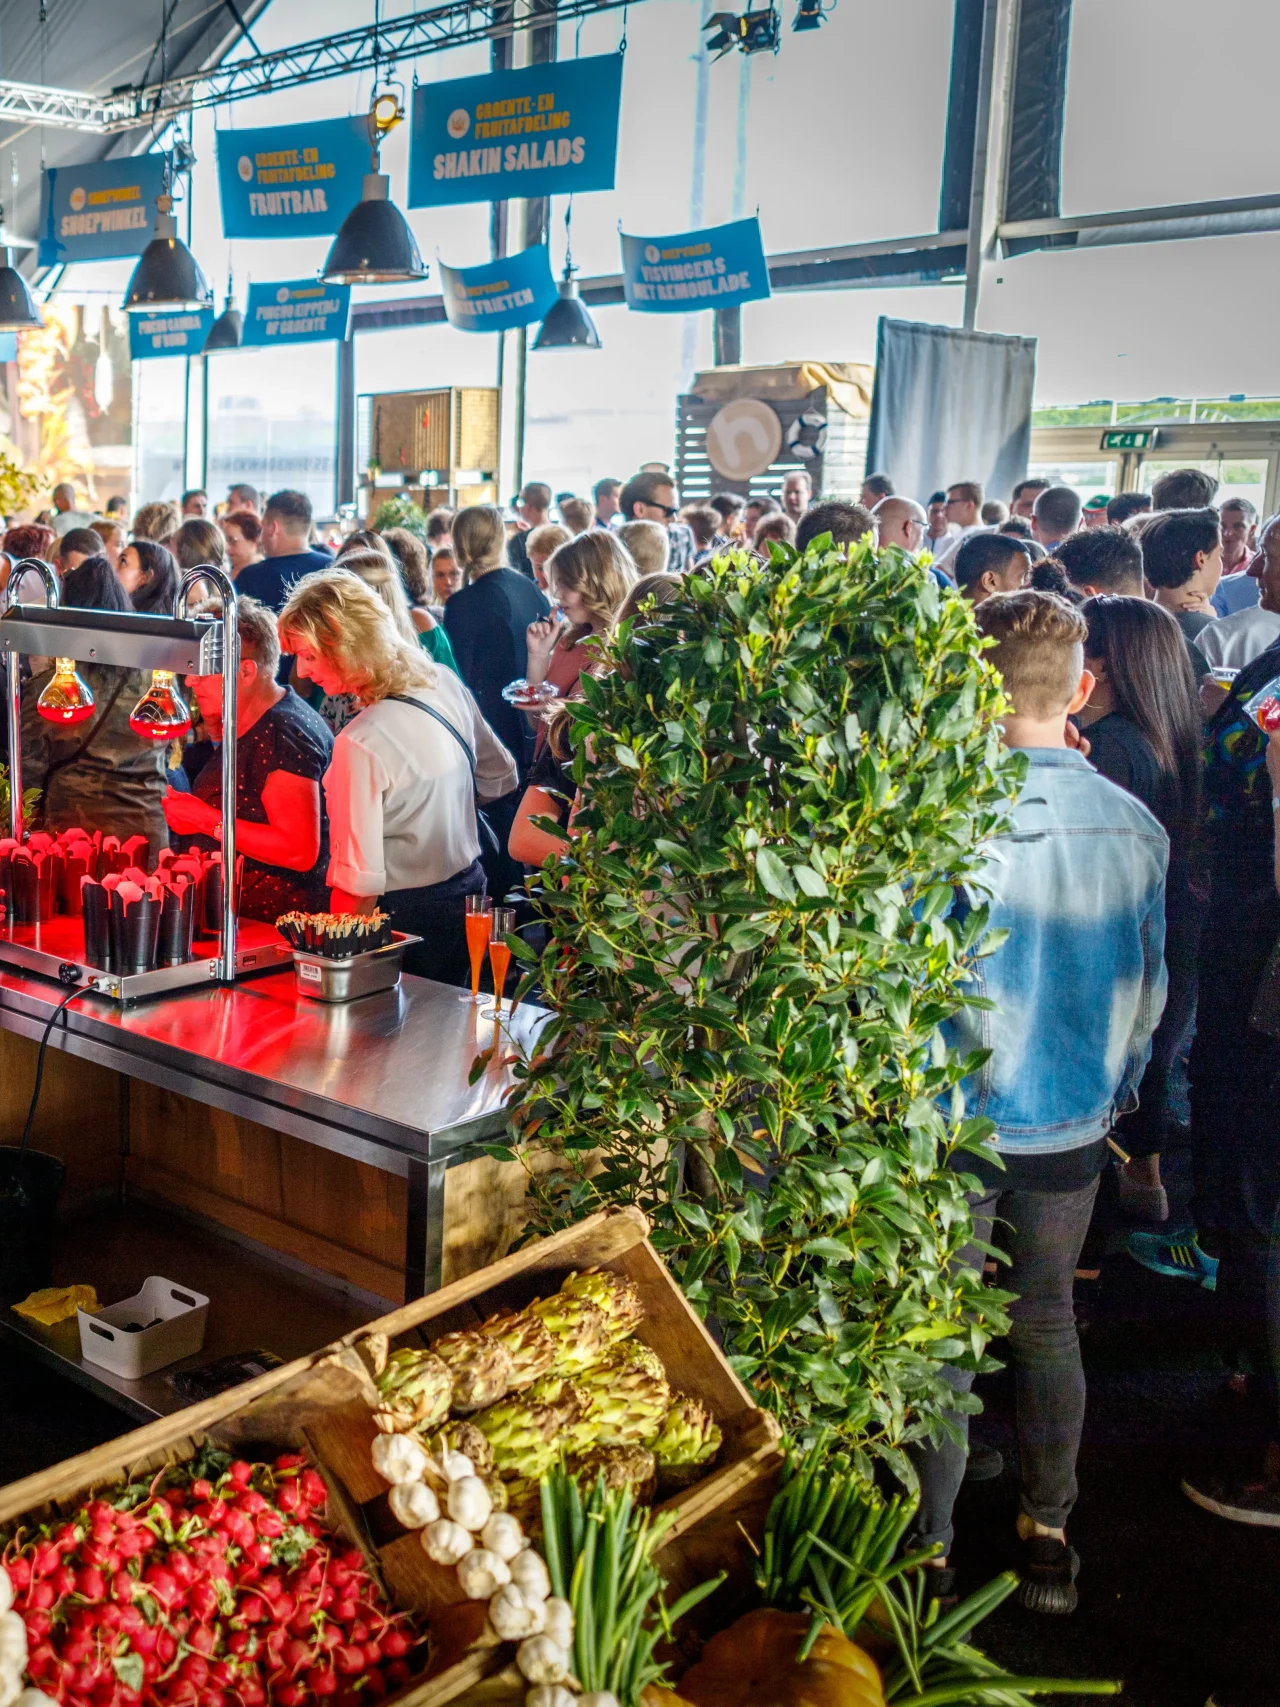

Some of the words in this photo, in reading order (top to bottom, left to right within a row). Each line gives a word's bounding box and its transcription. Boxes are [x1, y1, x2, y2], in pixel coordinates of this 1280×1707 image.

[474, 111, 570, 139] FRUITAFDELING
[433, 146, 501, 180] SHAKIN
[504, 136, 586, 171] SALADS
[257, 163, 336, 184] FRUITAFDELING
[249, 188, 328, 216] FRUITBAR
[61, 206, 148, 237] SNOEPWINKEL
[641, 256, 727, 282] VISVINGERS
[632, 283, 657, 300] MET
[657, 271, 751, 300] REMOULADE
